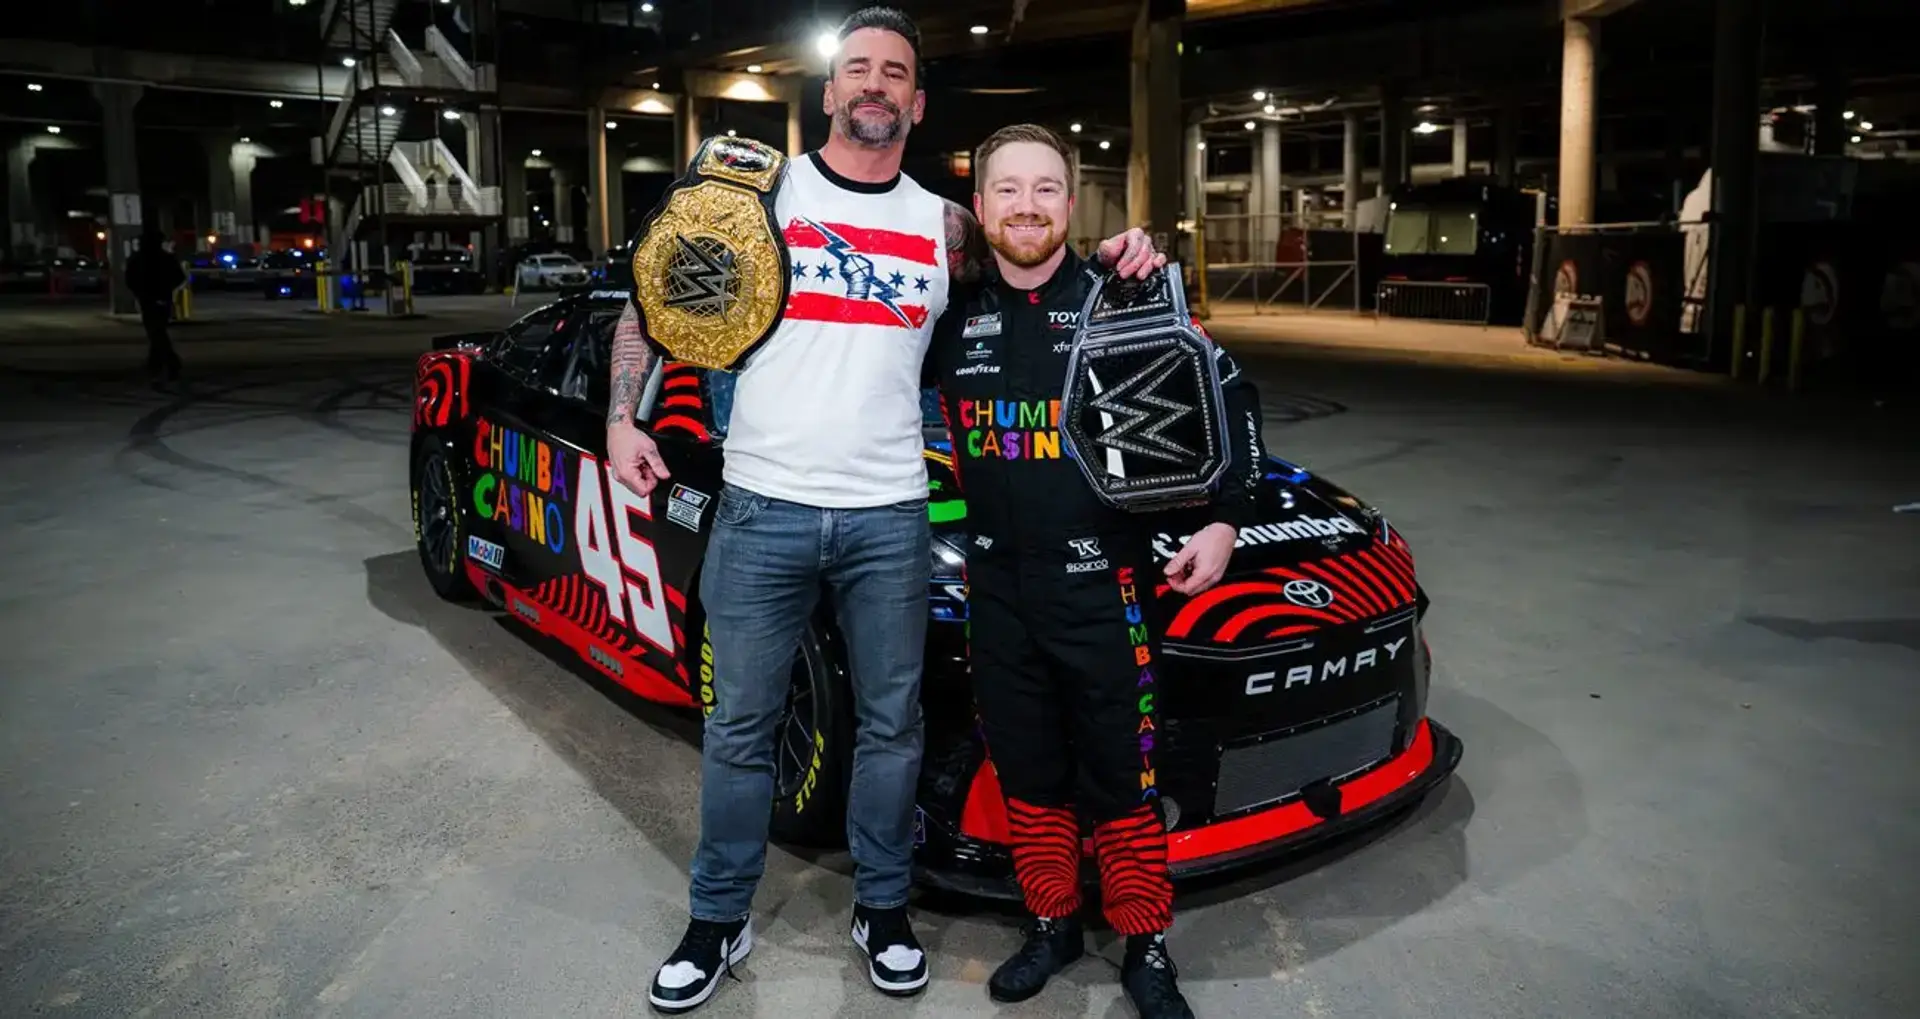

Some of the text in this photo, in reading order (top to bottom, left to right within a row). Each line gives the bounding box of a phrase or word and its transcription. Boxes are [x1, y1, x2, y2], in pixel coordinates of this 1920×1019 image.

[1048, 312, 1080, 323] TOY
[473, 416, 568, 502] CHUMBA
[471, 538, 495, 562] Mobil
[473, 473, 564, 554] CASINO
[575, 452, 676, 658] 45
[1066, 559, 1109, 573] sparco
[1118, 567, 1153, 687] CHUMBA
[796, 729, 824, 814] EAGLE
